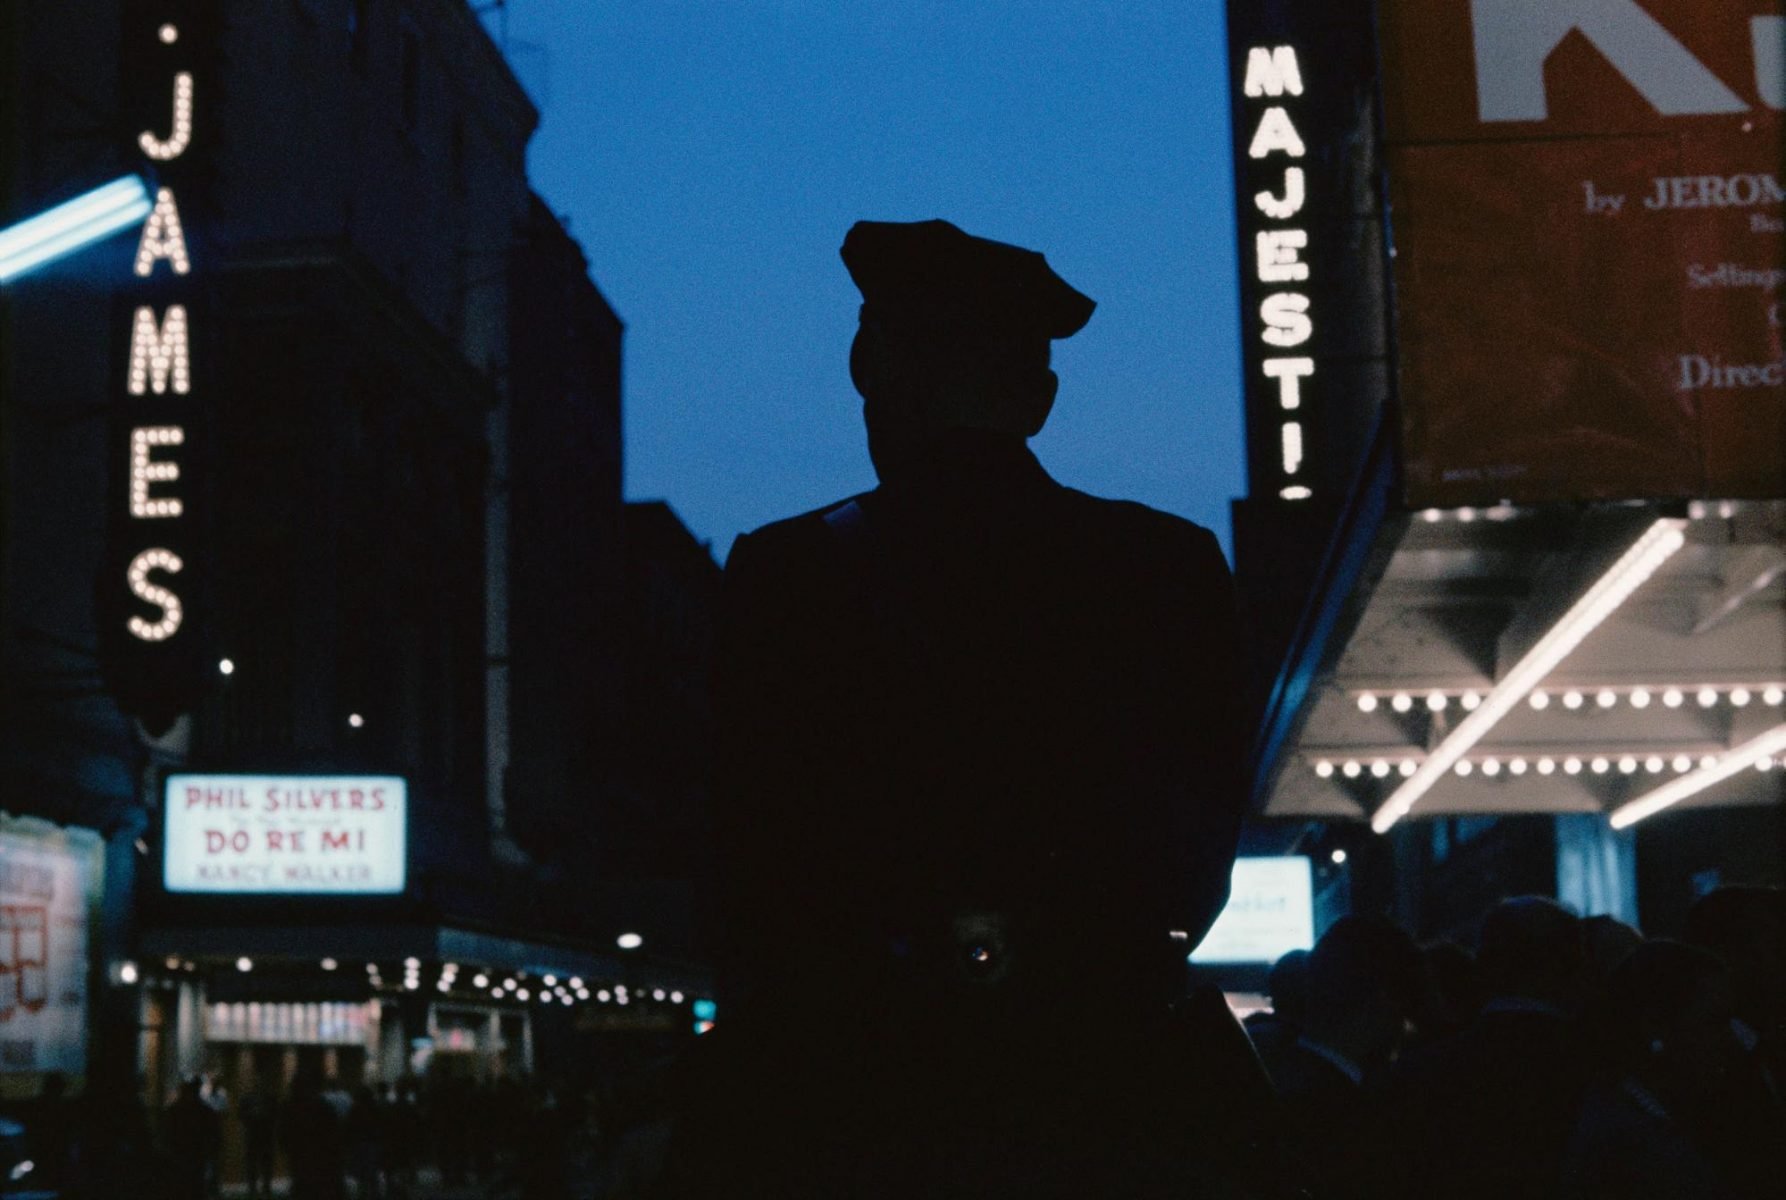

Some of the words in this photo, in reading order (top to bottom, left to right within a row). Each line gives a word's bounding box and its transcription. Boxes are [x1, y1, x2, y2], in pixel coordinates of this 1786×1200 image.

[1581, 179, 1626, 216] by
[1244, 45, 1315, 500] MAJESTI
[185, 786, 251, 811] PHIL
[264, 786, 386, 812] SILVERS
[204, 829, 250, 854] DO
[266, 830, 305, 852] RE
[321, 829, 366, 854] MI
